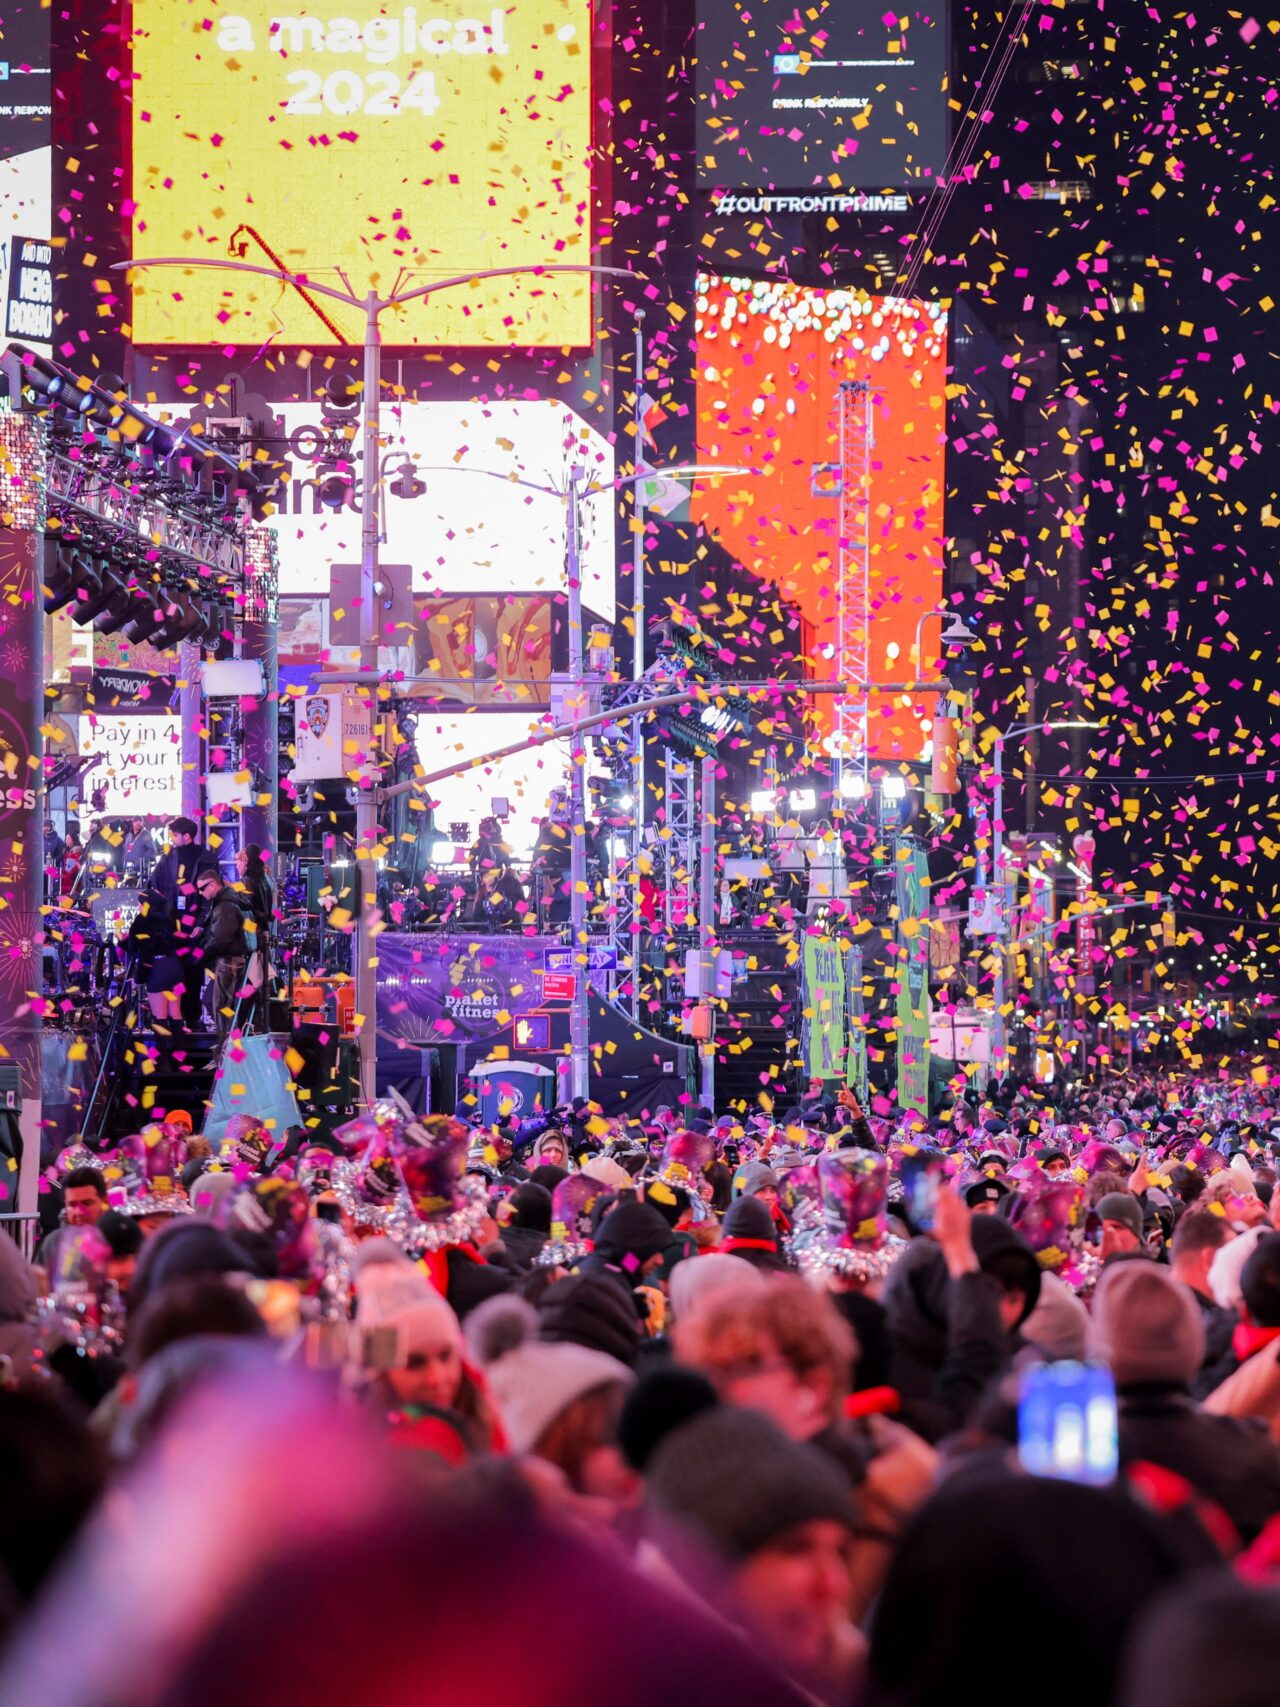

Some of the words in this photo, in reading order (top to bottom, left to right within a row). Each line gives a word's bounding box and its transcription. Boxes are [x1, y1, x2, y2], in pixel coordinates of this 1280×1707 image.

[216, 15, 255, 50] a
[269, 7, 509, 63] magical
[285, 70, 441, 115] 2024
[772, 98, 803, 109] DRINK
[804, 98, 869, 109] RESPONSIBLY
[715, 195, 908, 215] #OUTFRONTPRIME
[92, 724, 131, 747] Pay
[138, 722, 156, 741] in
[119, 751, 168, 771] your
[451, 1004, 509, 1019] fitnes
